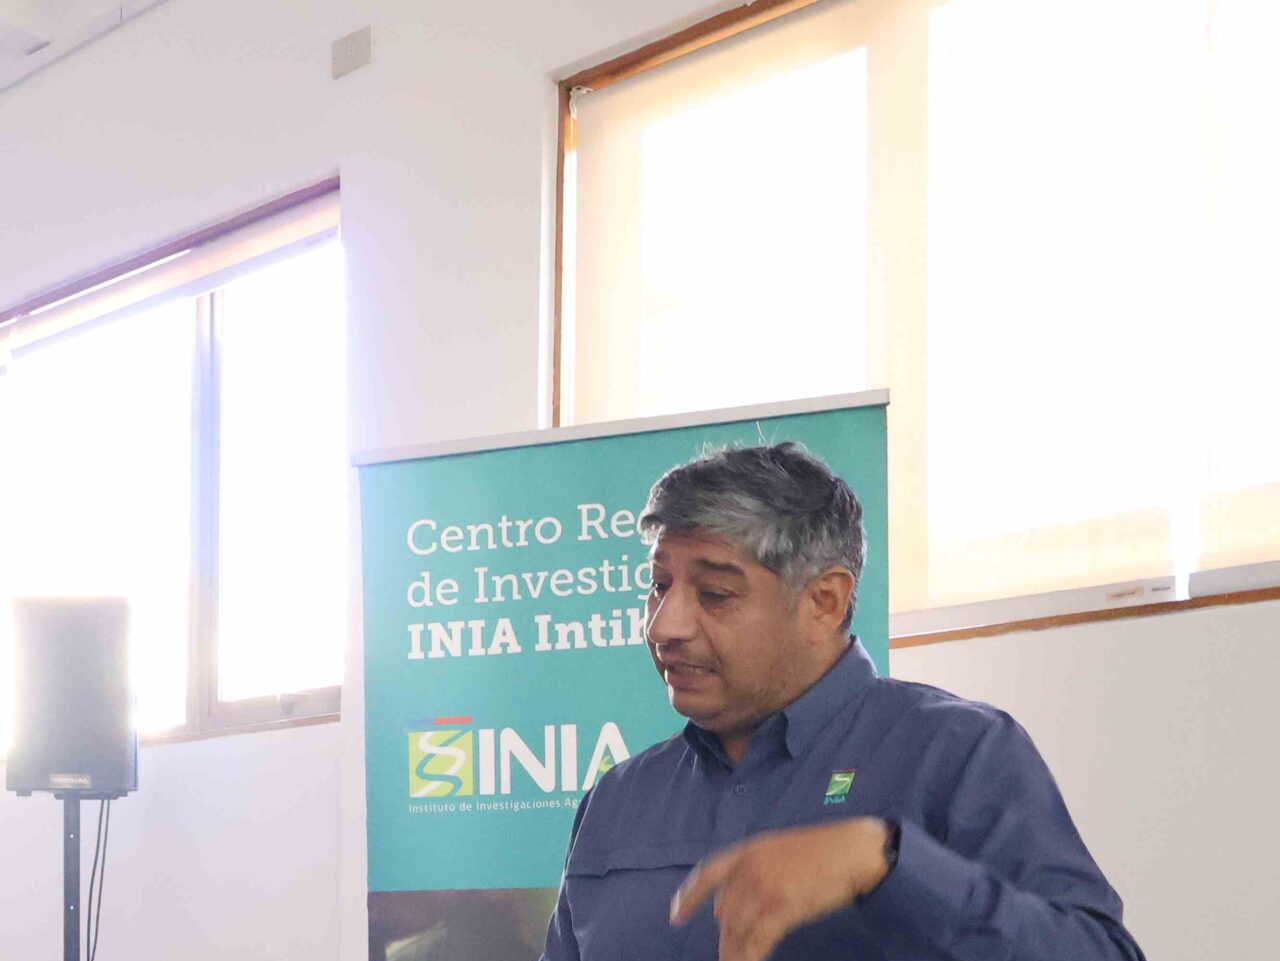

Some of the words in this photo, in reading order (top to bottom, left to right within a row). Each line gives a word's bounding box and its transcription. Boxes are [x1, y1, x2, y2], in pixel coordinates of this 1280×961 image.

[406, 514, 562, 556] Centro
[406, 571, 459, 608] de
[407, 617, 522, 660] INIA
[478, 721, 631, 796] INIA
[408, 802, 456, 813] Instituto
[459, 800, 472, 811] de
[476, 799, 561, 812] Investigaciones
